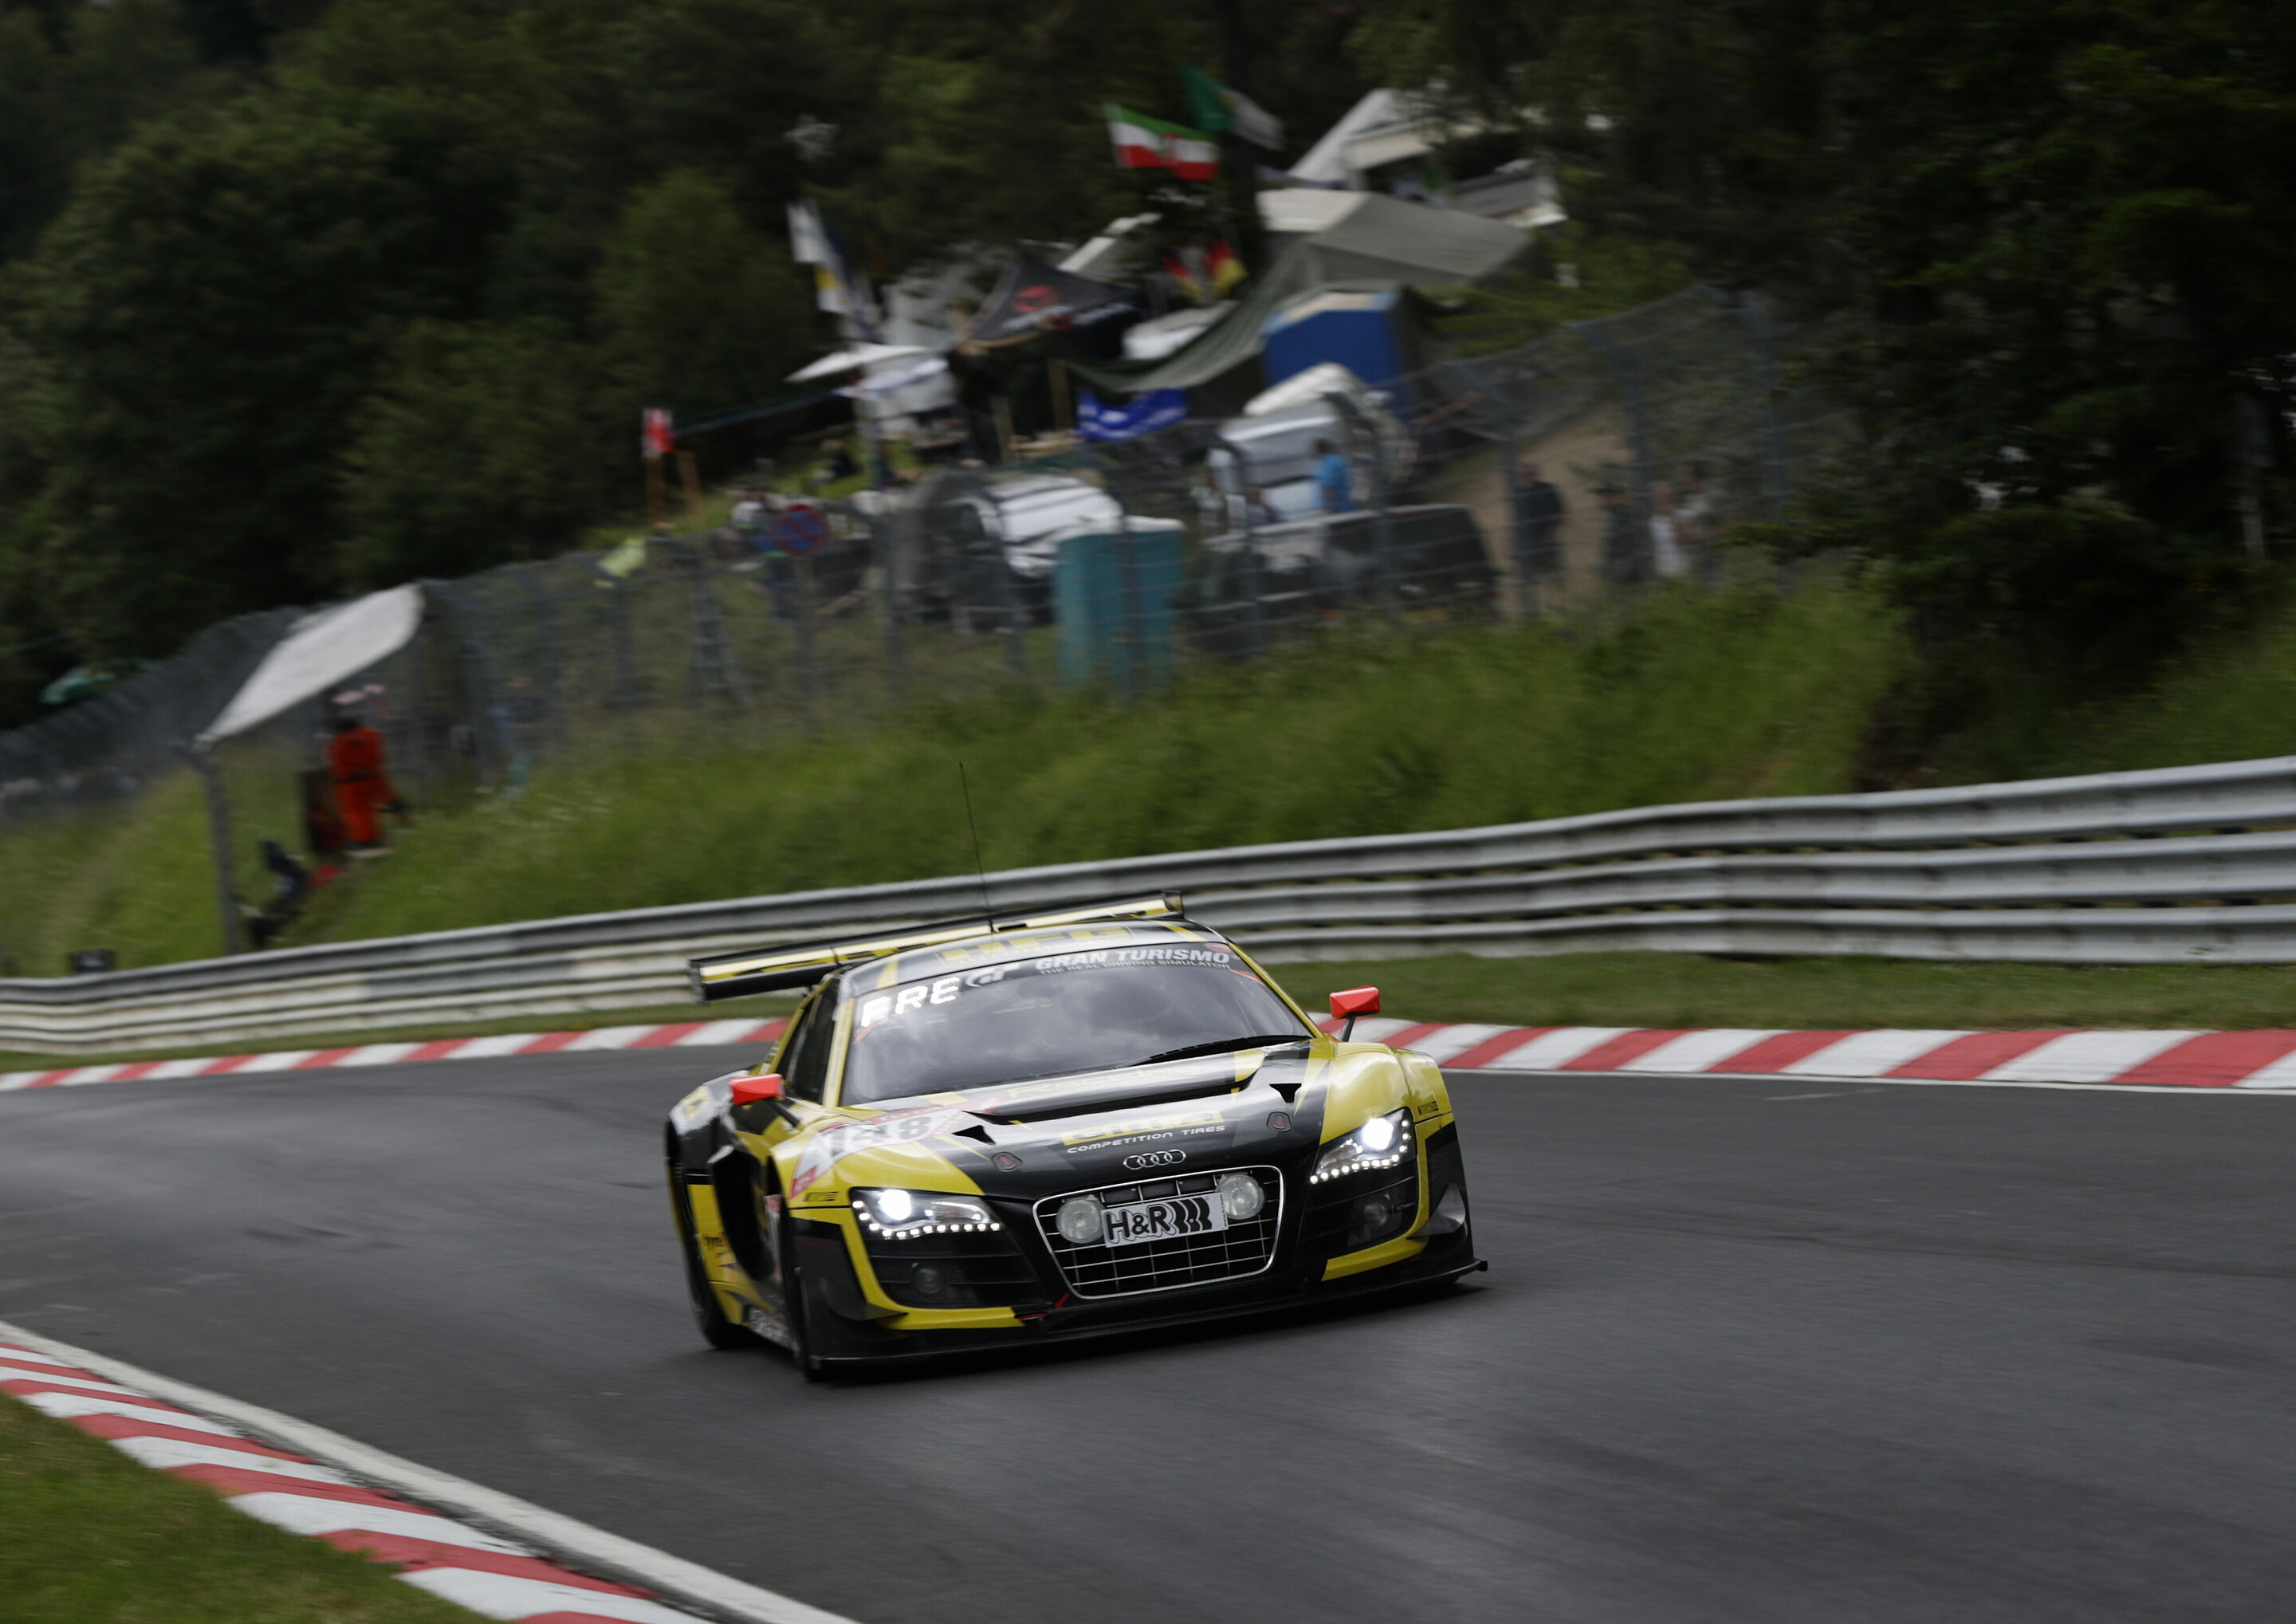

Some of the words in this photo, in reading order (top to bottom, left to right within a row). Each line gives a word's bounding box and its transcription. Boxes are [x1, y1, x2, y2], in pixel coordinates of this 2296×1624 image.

[1035, 952, 1108, 970] GRAN
[1115, 948, 1230, 964] TURISMO
[1039, 966, 1065, 975] THE
[1066, 962, 1098, 972] REAL
[1102, 959, 1156, 968] DRIVING
[1158, 959, 1231, 969] SIMULATOR
[1067, 1131, 1174, 1154] COMPETITION
[1181, 1125, 1226, 1136] TIRES
[1105, 1205, 1173, 1241] H&R
